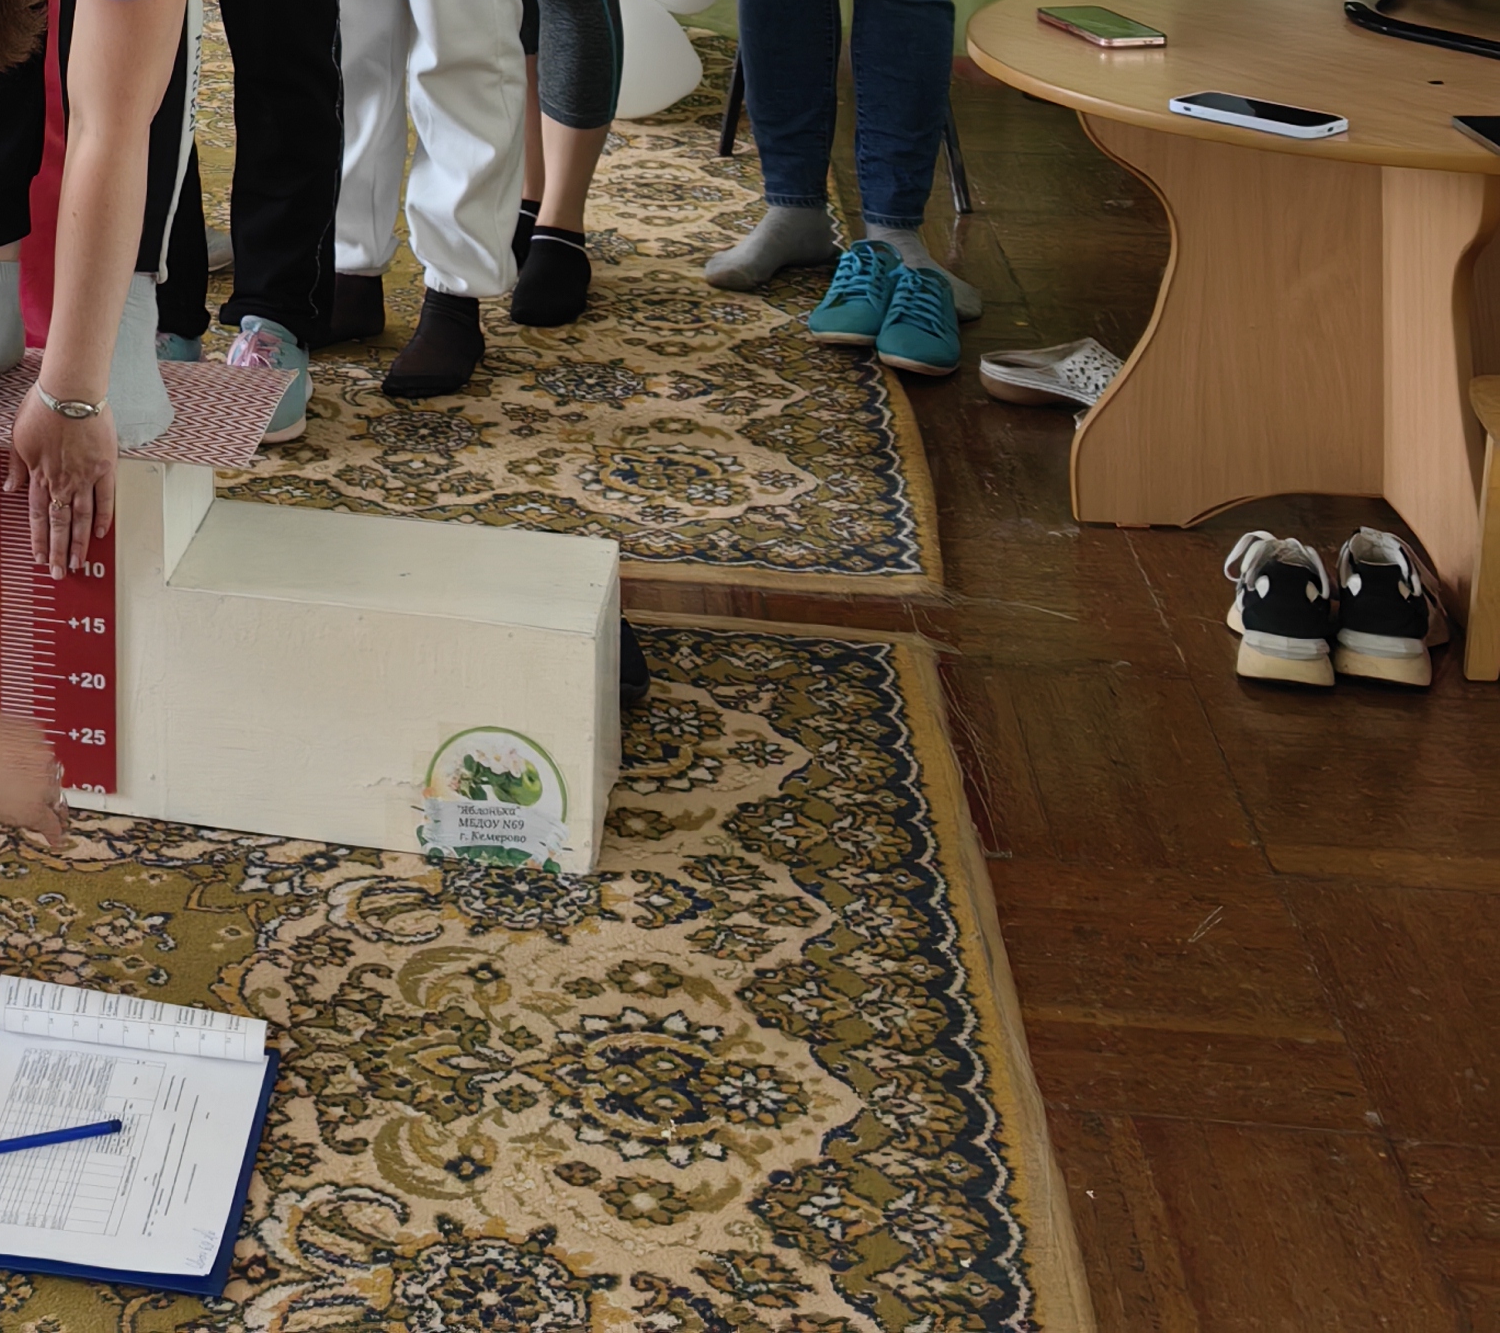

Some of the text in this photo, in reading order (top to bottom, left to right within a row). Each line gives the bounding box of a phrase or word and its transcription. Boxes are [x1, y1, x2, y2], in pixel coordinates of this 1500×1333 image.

[72, 560, 106, 579] 10
[68, 616, 106, 634] +15
[68, 672, 106, 690] +20
[68, 728, 106, 745] +25
[471, 831, 527, 844] Кемерово
